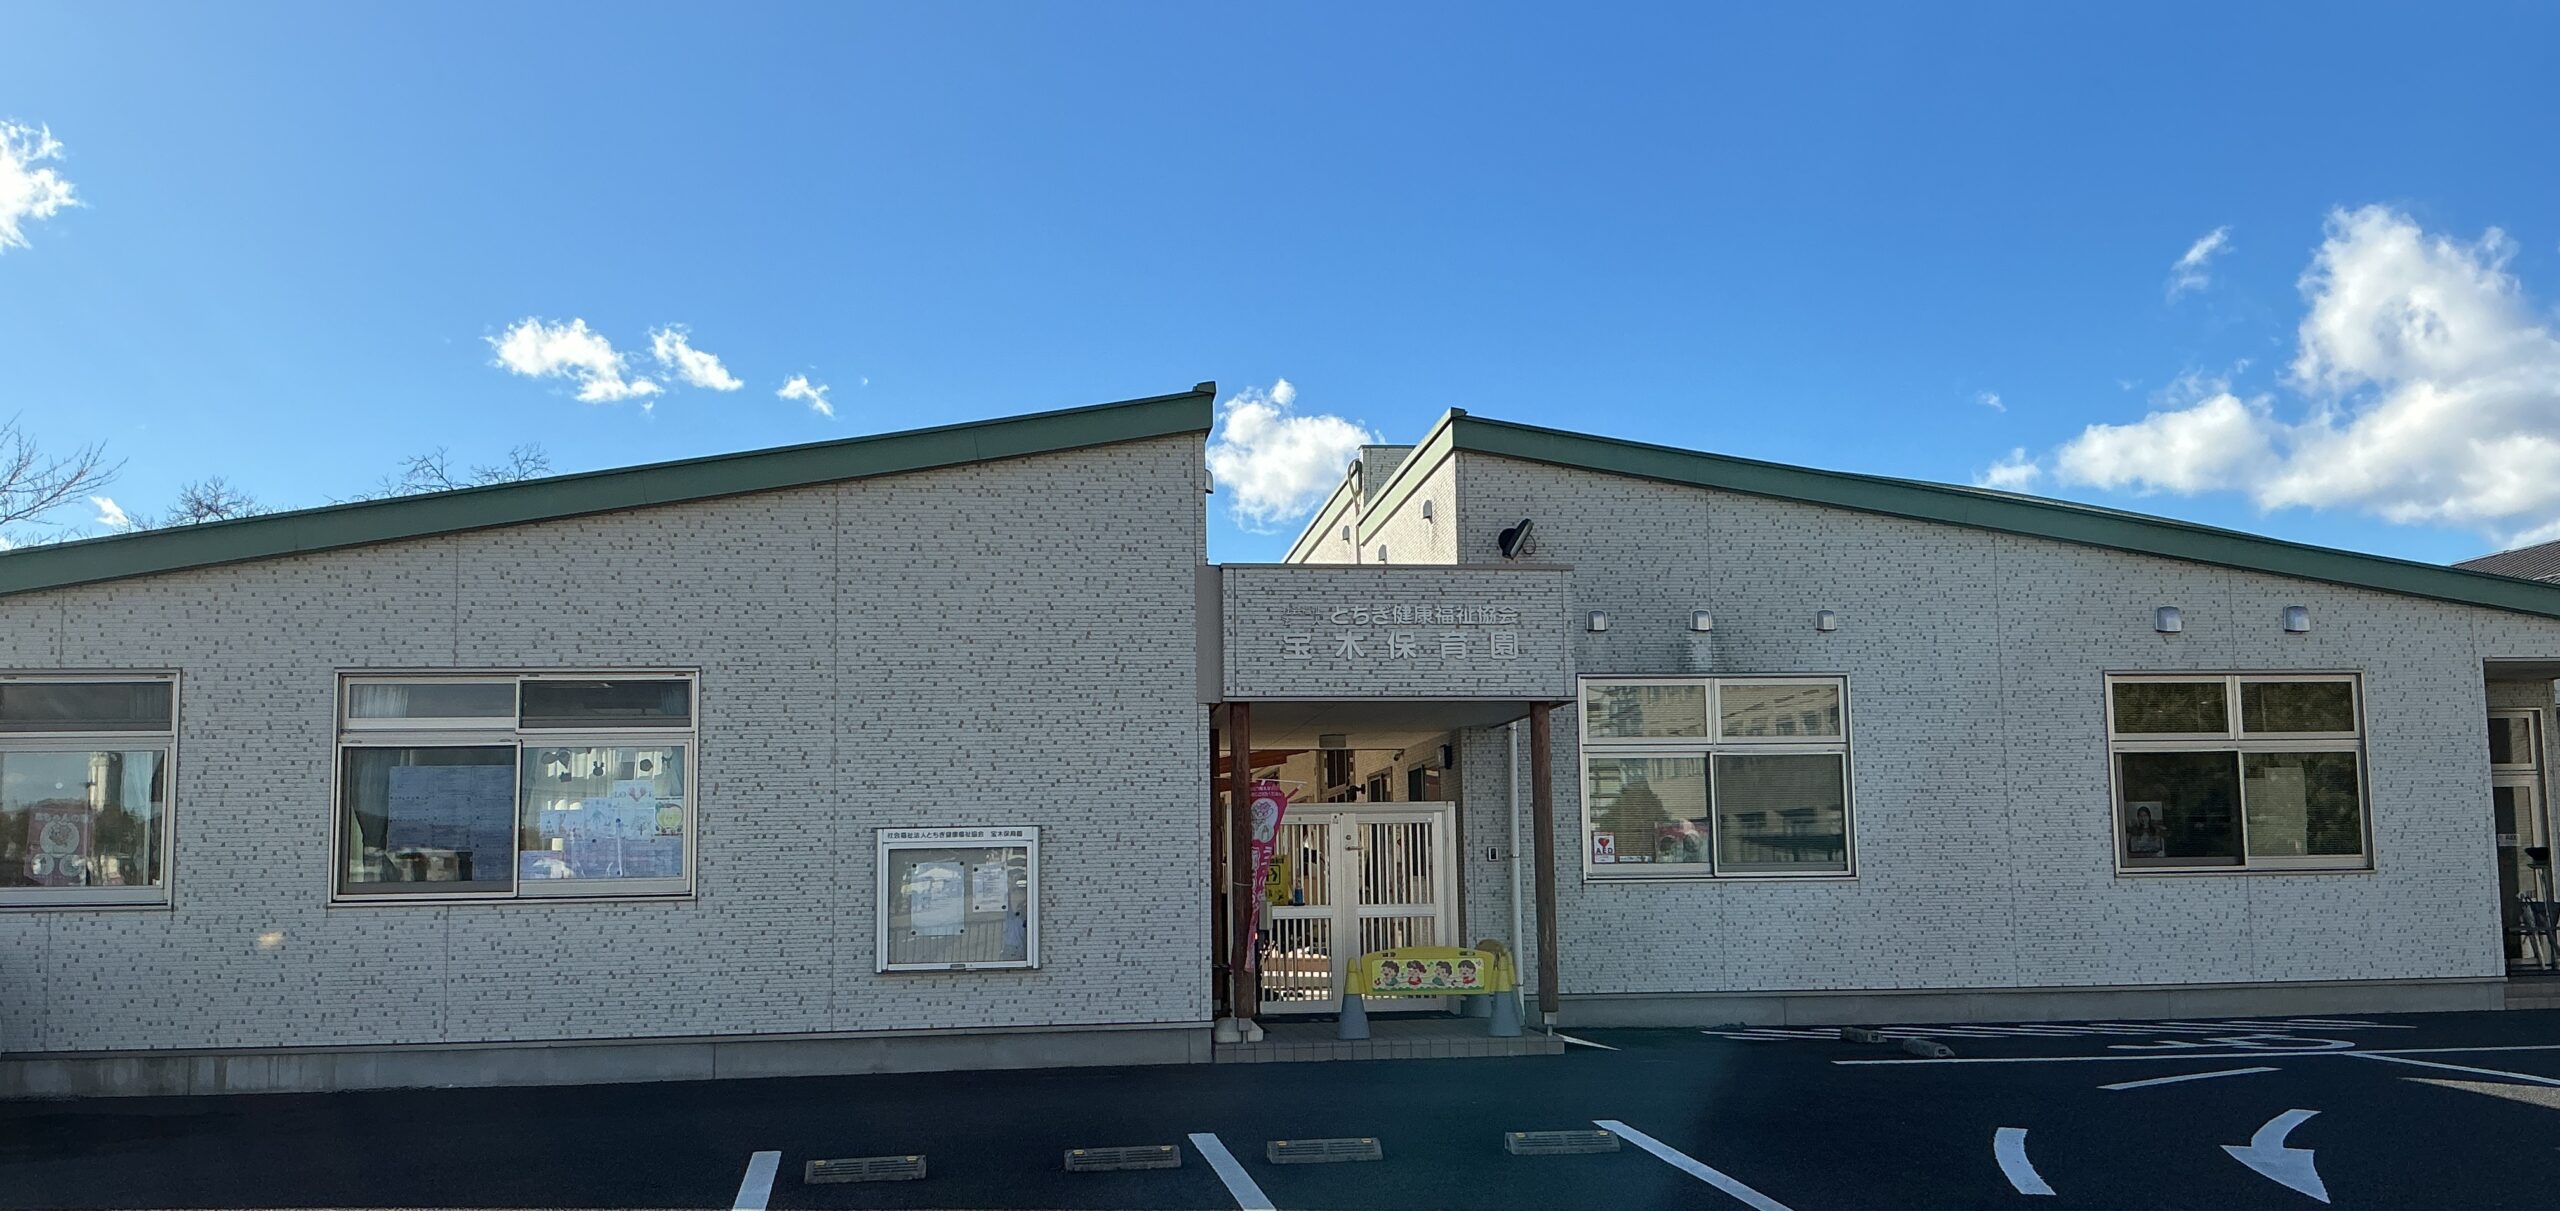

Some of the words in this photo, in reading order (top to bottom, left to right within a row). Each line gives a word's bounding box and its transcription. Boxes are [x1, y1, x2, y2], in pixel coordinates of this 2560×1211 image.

[1330, 604, 1520, 625] とちぎ健康福祉協会
[1283, 631, 1520, 660] 宝木保育園
[1596, 847, 1614, 855] AED
